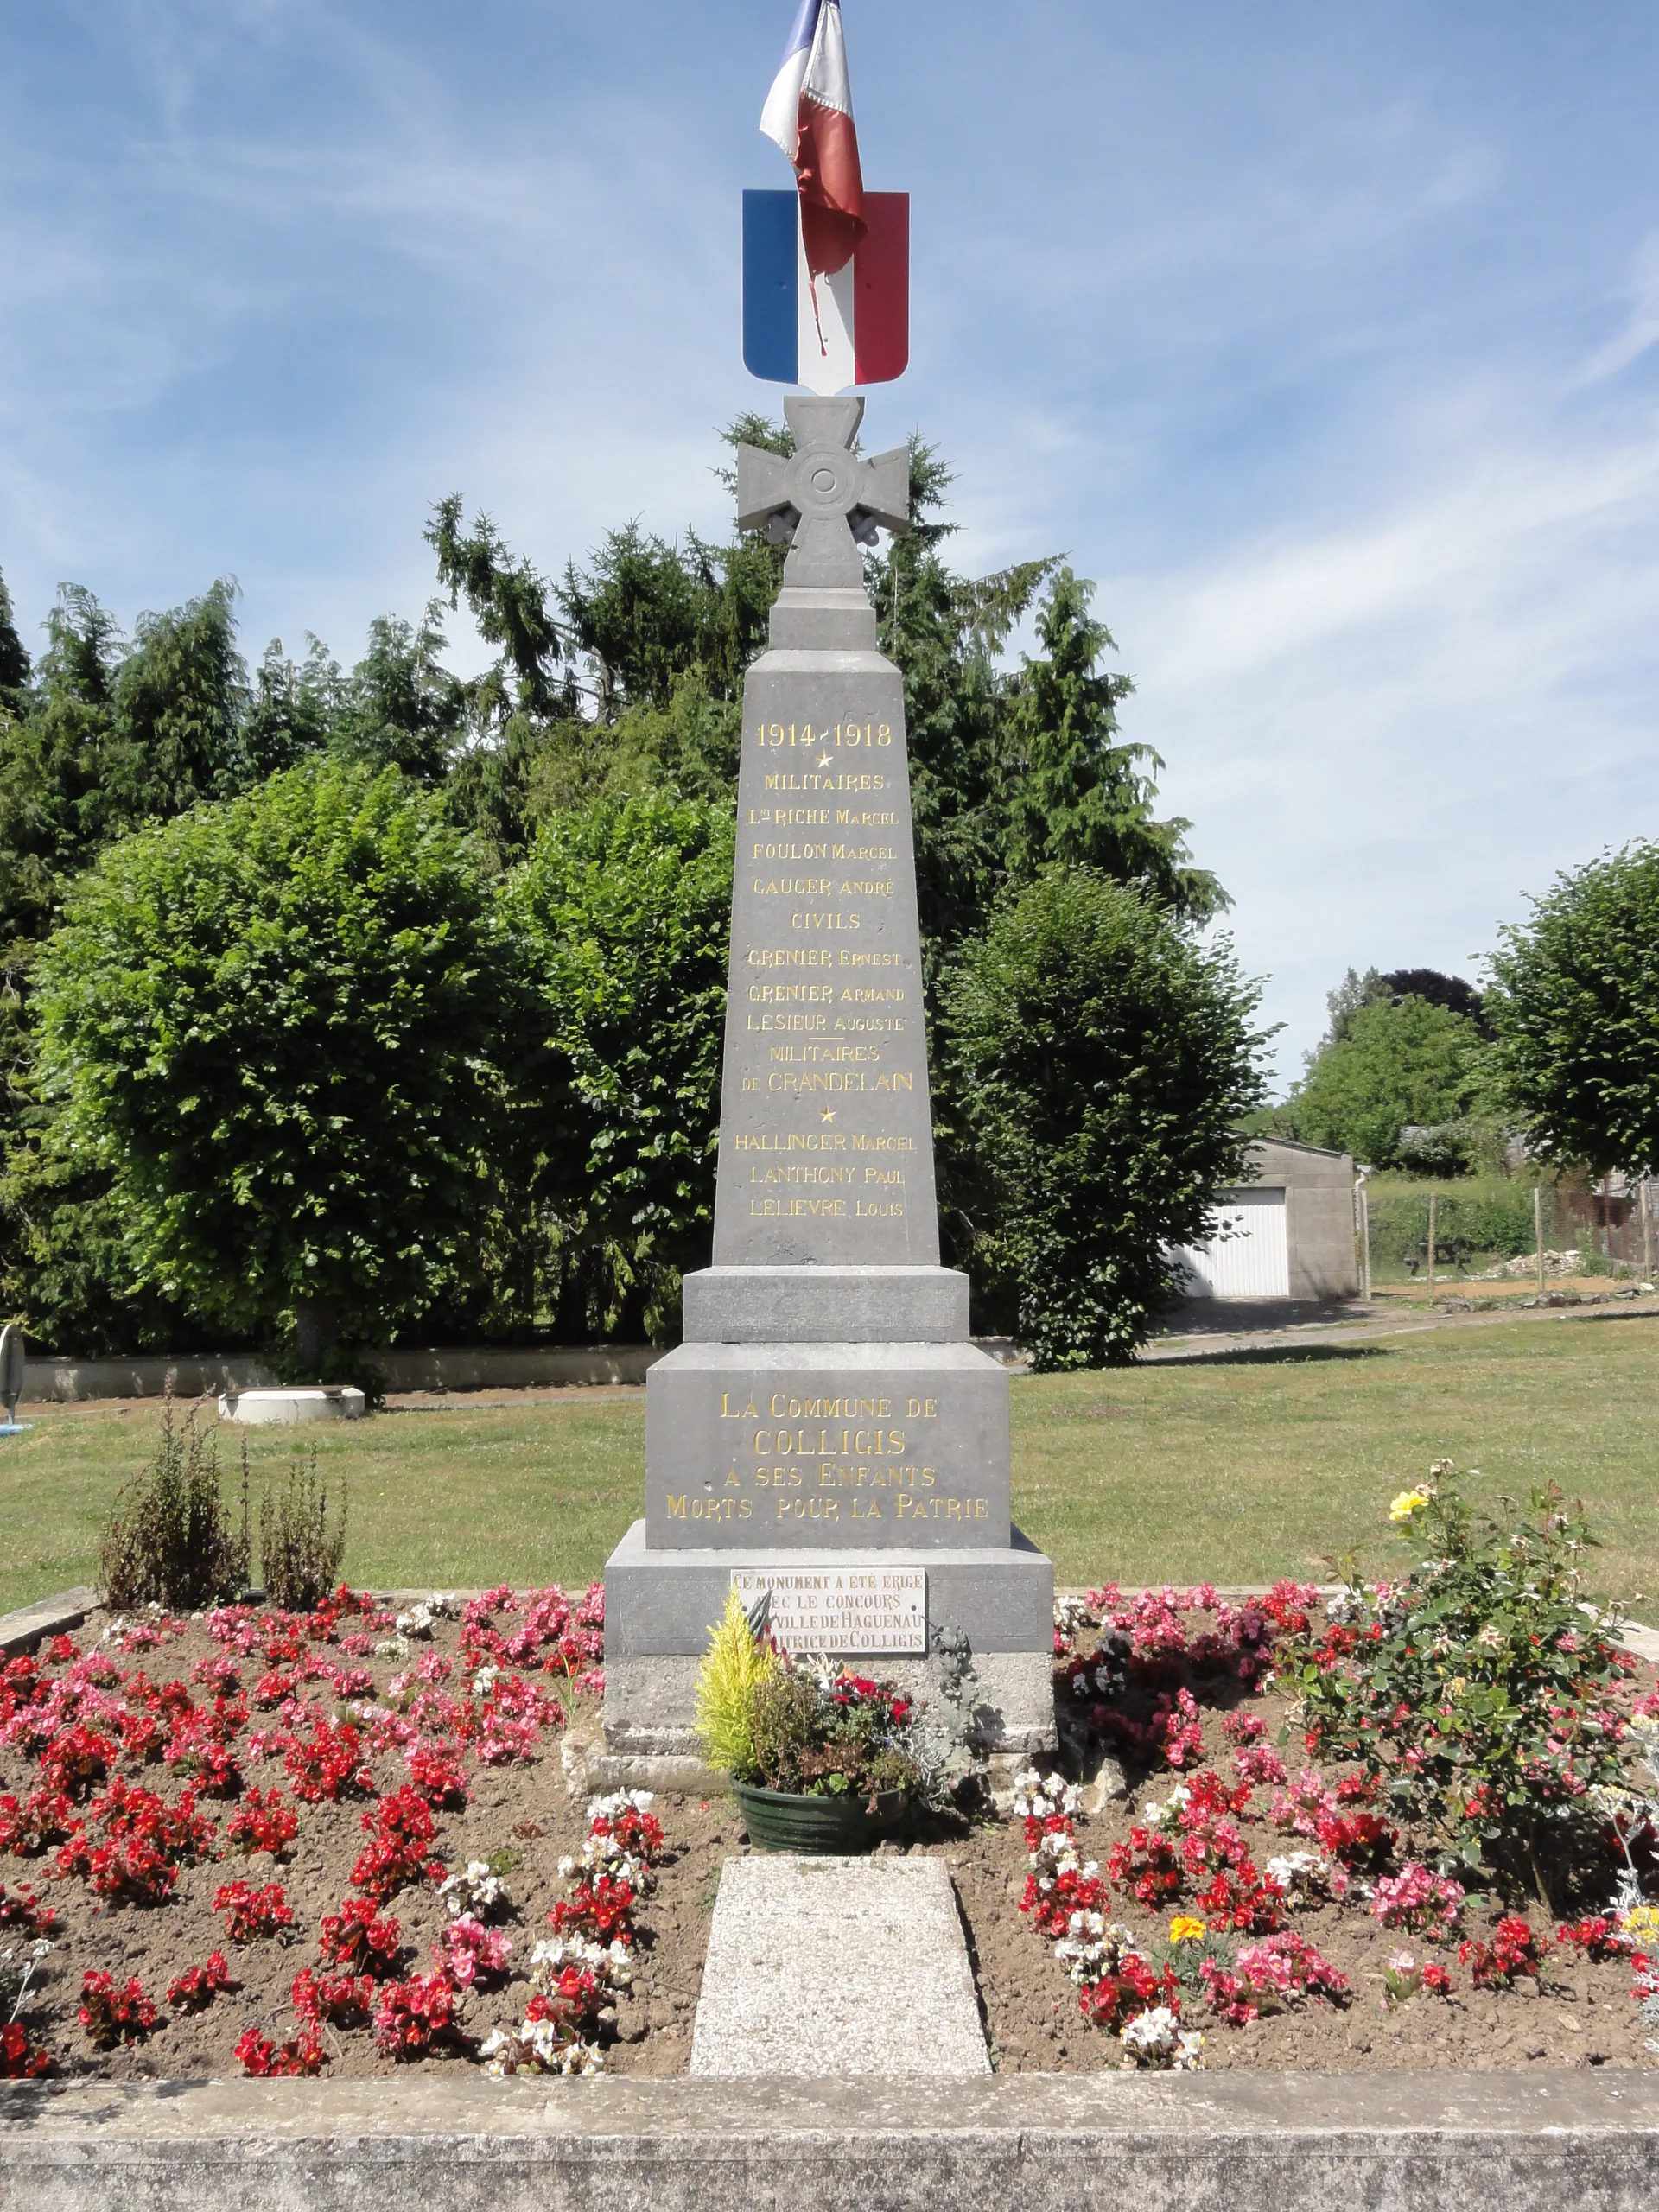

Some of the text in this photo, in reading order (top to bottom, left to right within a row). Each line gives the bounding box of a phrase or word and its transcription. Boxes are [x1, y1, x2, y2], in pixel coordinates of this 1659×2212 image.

[765, 774, 884, 792] MILITAIRES
[775, 809, 830, 827] RICHE
[836, 809, 899, 826] MARCEL
[752, 843, 897, 861] FOULON MARCEL
[839, 877, 894, 896] ANDRÉ
[791, 913, 861, 929] CIVILS
[747, 950, 901, 968] GRENIER ERNEST
[748, 985, 905, 1004] GRENIER ARMAND
[747, 1014, 905, 1031] LESIEUR AUGUSTE
[770, 1046, 880, 1062] MILITAIRES
[742, 1072, 912, 1091] DE CRANDELAIN
[734, 1134, 918, 1150] HALLINGER MARCEL
[750, 1166, 906, 1184] LANTHONY PAUL
[750, 1199, 903, 1217] LELIEVRE LOUIS
[721, 1392, 937, 1419] LA COMMUNE DE
[753, 1429, 906, 1455] COLLIGIS
[724, 1462, 936, 1486] A SES ENFANTS
[666, 1493, 988, 1522] MORTS POUR LA PATRIE
[756, 1576, 830, 1590] MONUMENT
[835, 1576, 843, 1589] A
[849, 1572, 876, 1589] ÉTÉ
[796, 1595, 817, 1609] LE
[826, 1594, 900, 1611] CONCOURS
[776, 1611, 922, 1630] VILLE DE HAGUENAU
[829, 1634, 848, 1648] DE
[849, 1630, 923, 1649] COLLIGIS
